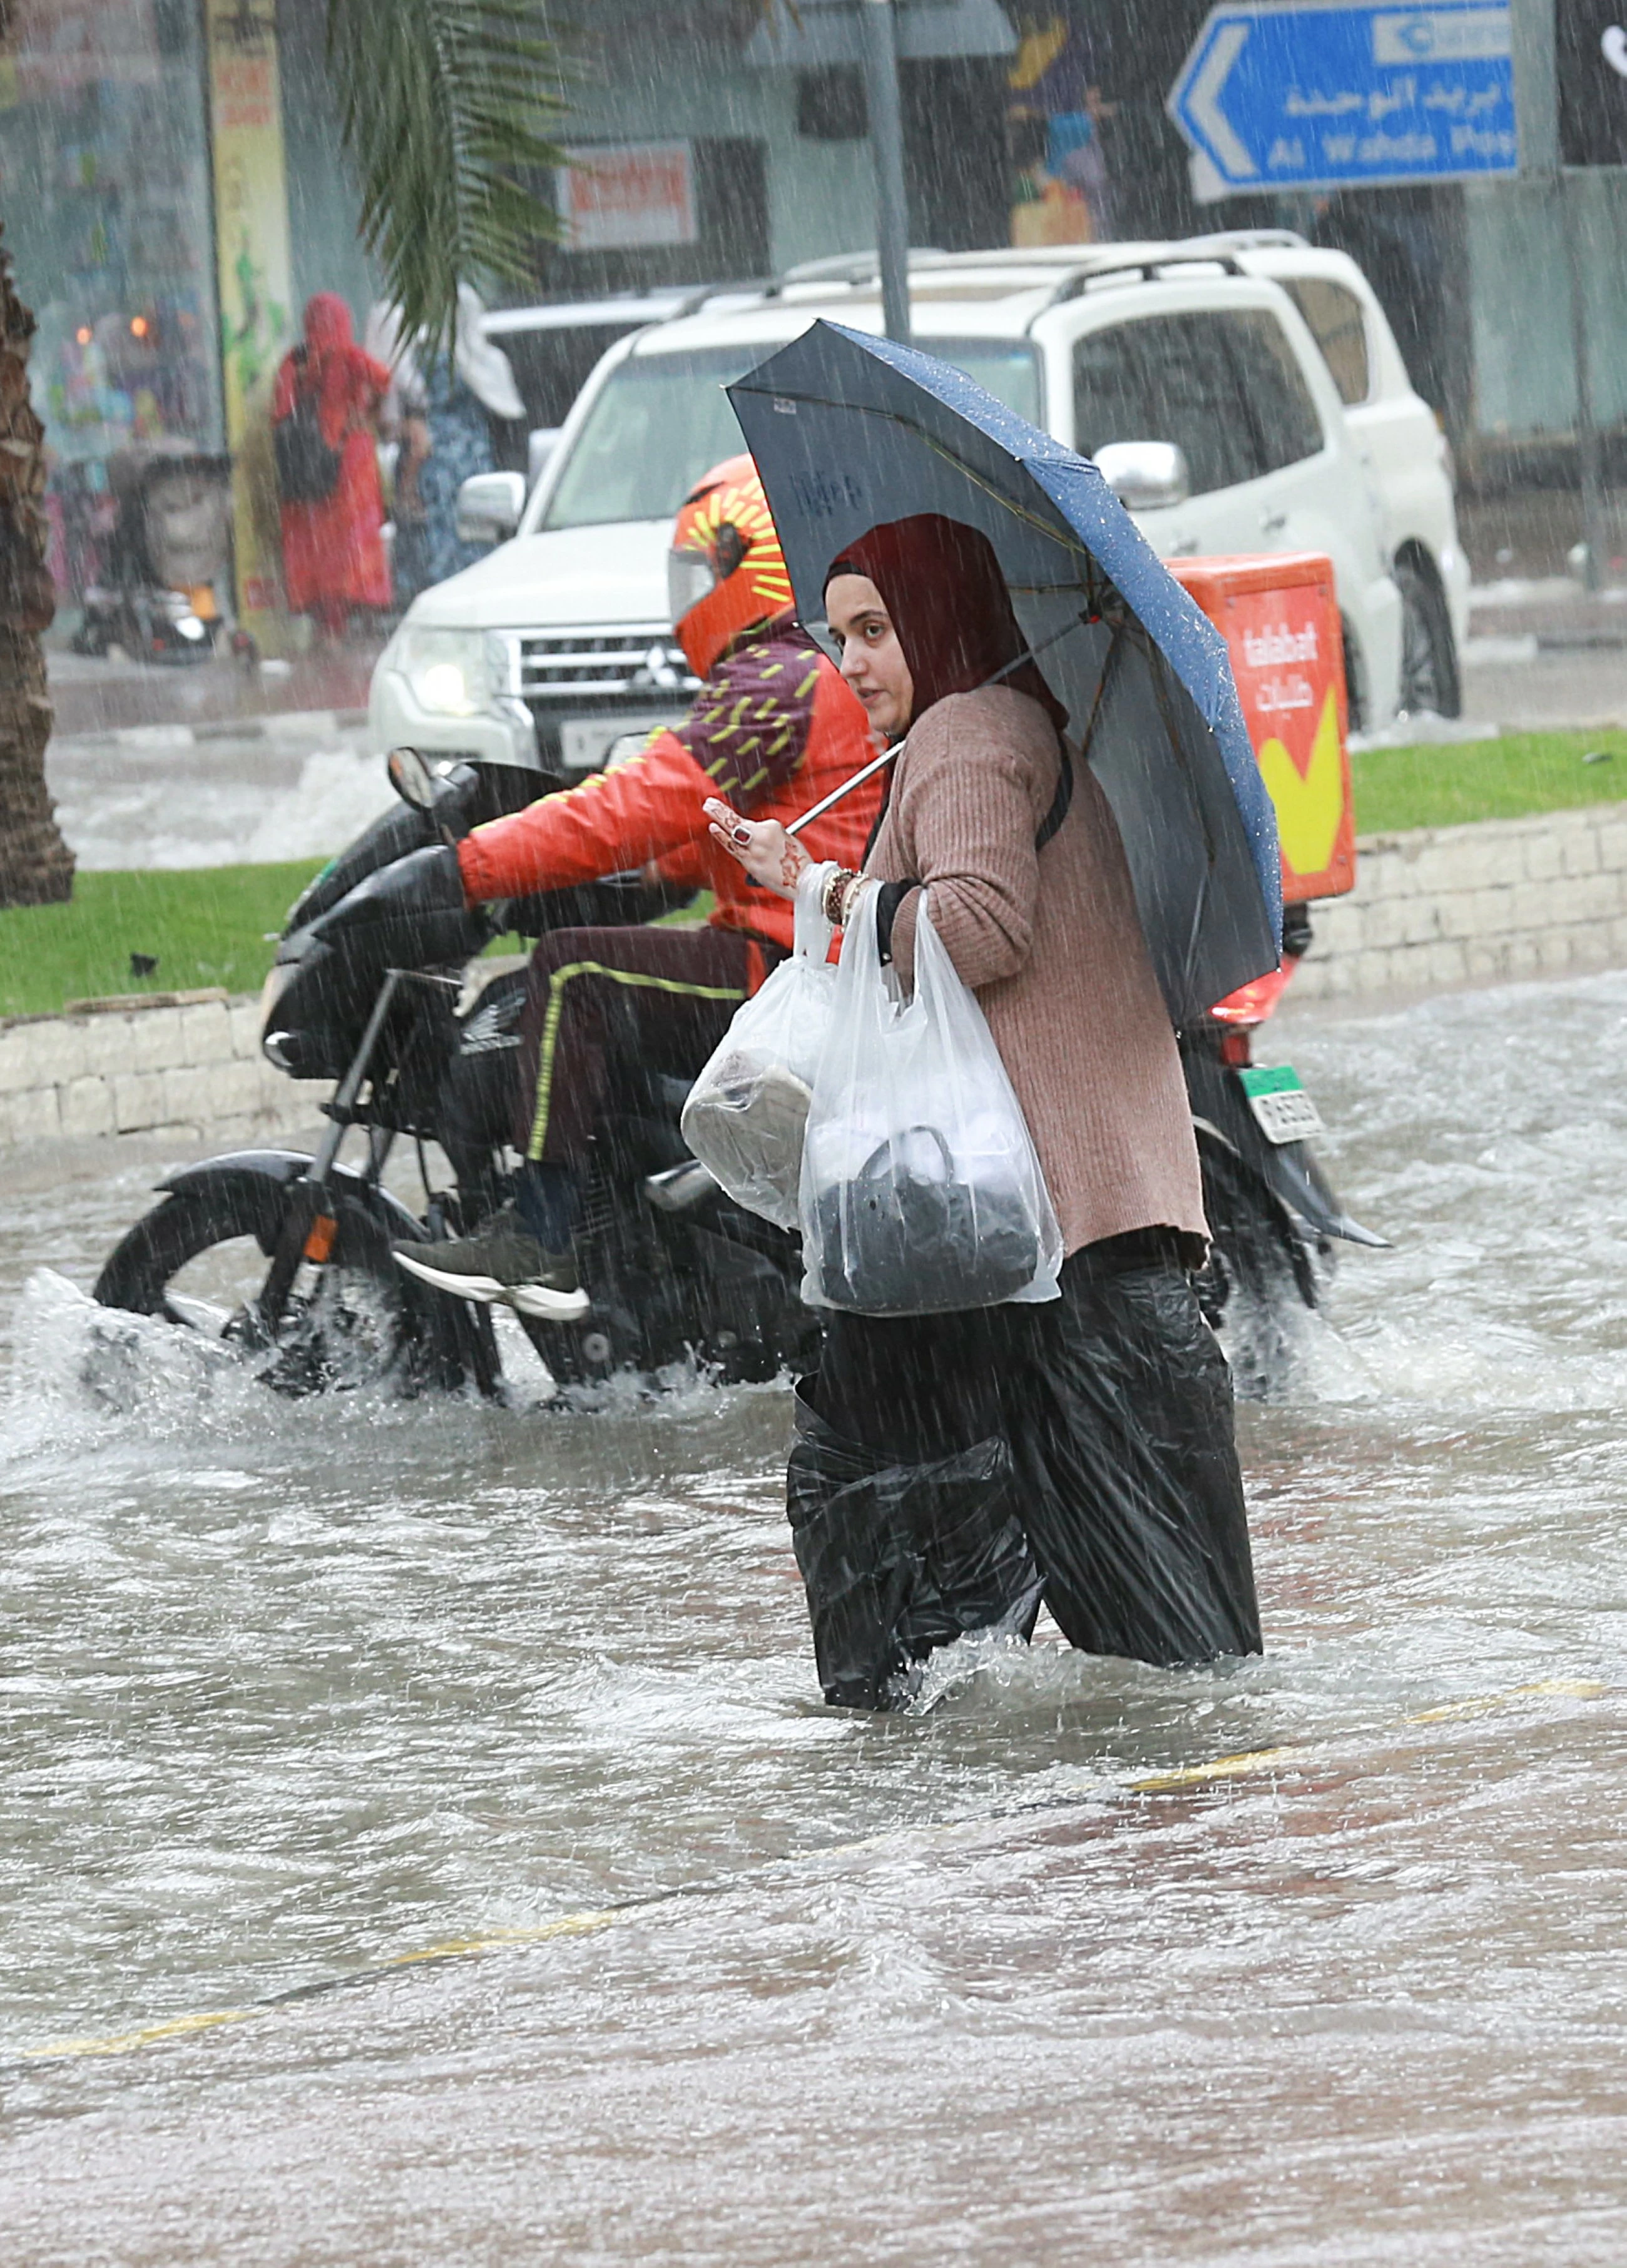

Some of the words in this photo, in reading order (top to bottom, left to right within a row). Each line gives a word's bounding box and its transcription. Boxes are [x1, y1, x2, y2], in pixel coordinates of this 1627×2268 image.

[1267, 136, 1305, 170] Al
[1321, 130, 1437, 163] Wahda
[1243, 621, 1318, 667] talabat
[1255, 673, 1313, 720] طلبات
